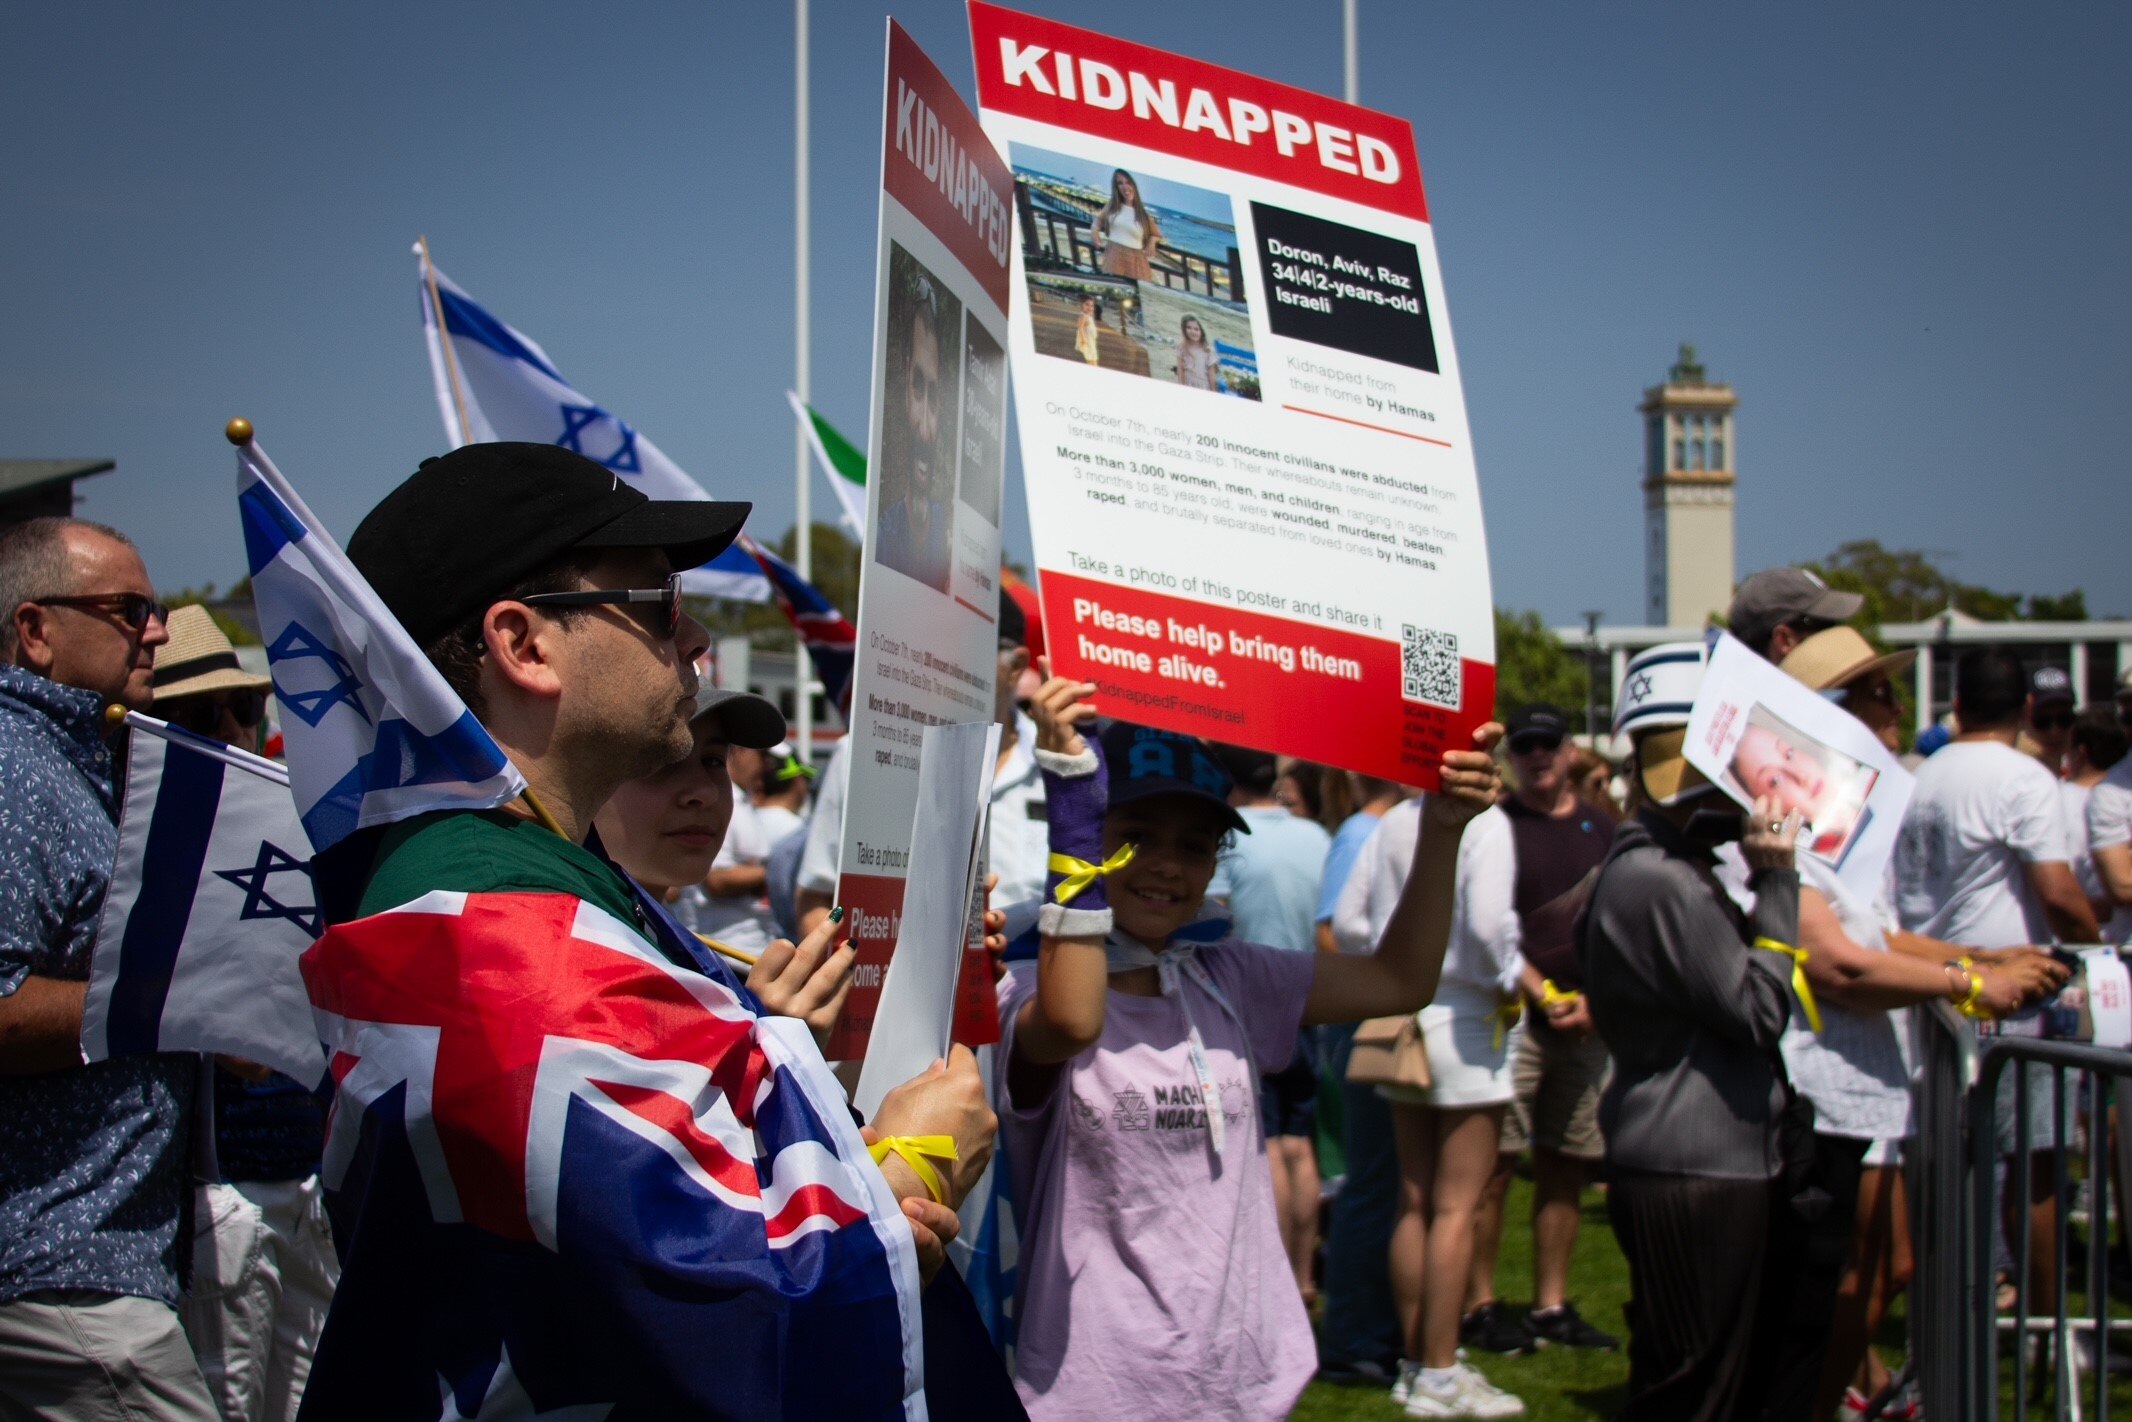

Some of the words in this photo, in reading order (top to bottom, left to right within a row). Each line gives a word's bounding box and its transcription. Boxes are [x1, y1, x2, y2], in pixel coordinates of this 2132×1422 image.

[999, 37, 1402, 186] KIDNAPPED
[896, 76, 1008, 268] KIDNAPPED
[1267, 238, 1329, 269] Doron,
[1332, 255, 1374, 281] Aviv,
[1377, 267, 1412, 290] Raz
[1275, 286, 1332, 314] Israeli
[1287, 355, 1363, 384] Kidnapped
[1367, 374, 1397, 394] from
[1290, 377, 1320, 394] their
[1325, 384, 1363, 404] home
[1366, 394, 1384, 412] by
[1388, 399, 1436, 422] Hamas
[1046, 402, 1065, 415] On
[1069, 406, 1122, 428] October
[1126, 418, 1150, 435] 7th,
[1153, 425, 1193, 445] nearly
[1196, 434, 1220, 448] 200
[1223, 438, 1280, 462] innocent
[1284, 453, 1336, 474] civilians
[1339, 466, 1369, 481] were
[1372, 473, 1428, 495] abducted
[1431, 484, 1457, 502] from
[1068, 423, 1104, 441] Israel
[1107, 432, 1131, 447] into
[1134, 438, 1155, 453] the
[1158, 442, 1192, 460] Gaza
[1195, 449, 1227, 468] Strip.
[1232, 456, 1261, 474] Their
[1266, 467, 1343, 492] whereabouts
[1346, 485, 1385, 502] remain
[1388, 494, 1441, 514] unknown.
[1056, 445, 1091, 463] More
[1095, 454, 1126, 471] than
[1129, 461, 1165, 479] 3,000
[1169, 471, 1221, 492] women,
[1225, 482, 1257, 499] men,
[1261, 489, 1285, 503] and
[1347, 508, 1391, 529] ranging
[1395, 519, 1405, 531] in
[1408, 522, 1429, 536] age
[1433, 525, 1458, 542] from
[1073, 466, 1083, 479] 3
[1086, 471, 1134, 490] months
[1137, 480, 1149, 493] to
[1153, 484, 1169, 498] 85
[1172, 488, 1207, 506] years
[1210, 495, 1235, 512] old,
[1238, 504, 1268, 517] were
[1086, 488, 1130, 508] raped,
[1134, 499, 1159, 513] and
[1162, 502, 1209, 525] brutally
[1212, 513, 1276, 537] separated
[1279, 524, 1307, 542] from
[1309, 532, 1342, 551] loved
[1345, 541, 1374, 557] ones
[1377, 547, 1391, 563] by
[1067, 550, 1108, 574] Take
[1114, 564, 1125, 578] a
[1130, 566, 1177, 589] photo
[1182, 577, 1198, 592] of
[1202, 580, 1232, 599] this
[1236, 587, 1287, 610] poster
[1292, 599, 1321, 617] and
[1326, 604, 1369, 627] share
[1373, 613, 1383, 631] it
[870, 631, 878, 648] On
[880, 634, 900, 656] October
[1073, 598, 1162, 639] Please
[1167, 617, 1224, 657] help
[1228, 629, 1296, 672] bring
[1300, 645, 1362, 682] them
[1077, 634, 1153, 673] home
[1157, 654, 1226, 689] alive.
[877, 661, 891, 677] Israel
[869, 693, 883, 712] More
[884, 698, 896, 715] than
[872, 720, 877, 736] 3
[877, 723, 896, 742] months
[893, 752, 903, 767] and
[857, 842, 875, 865] Take
[876, 848, 881, 865] a
[882, 845, 901, 871] photo
[850, 907, 889, 939] Please
[854, 963, 880, 987] ome
